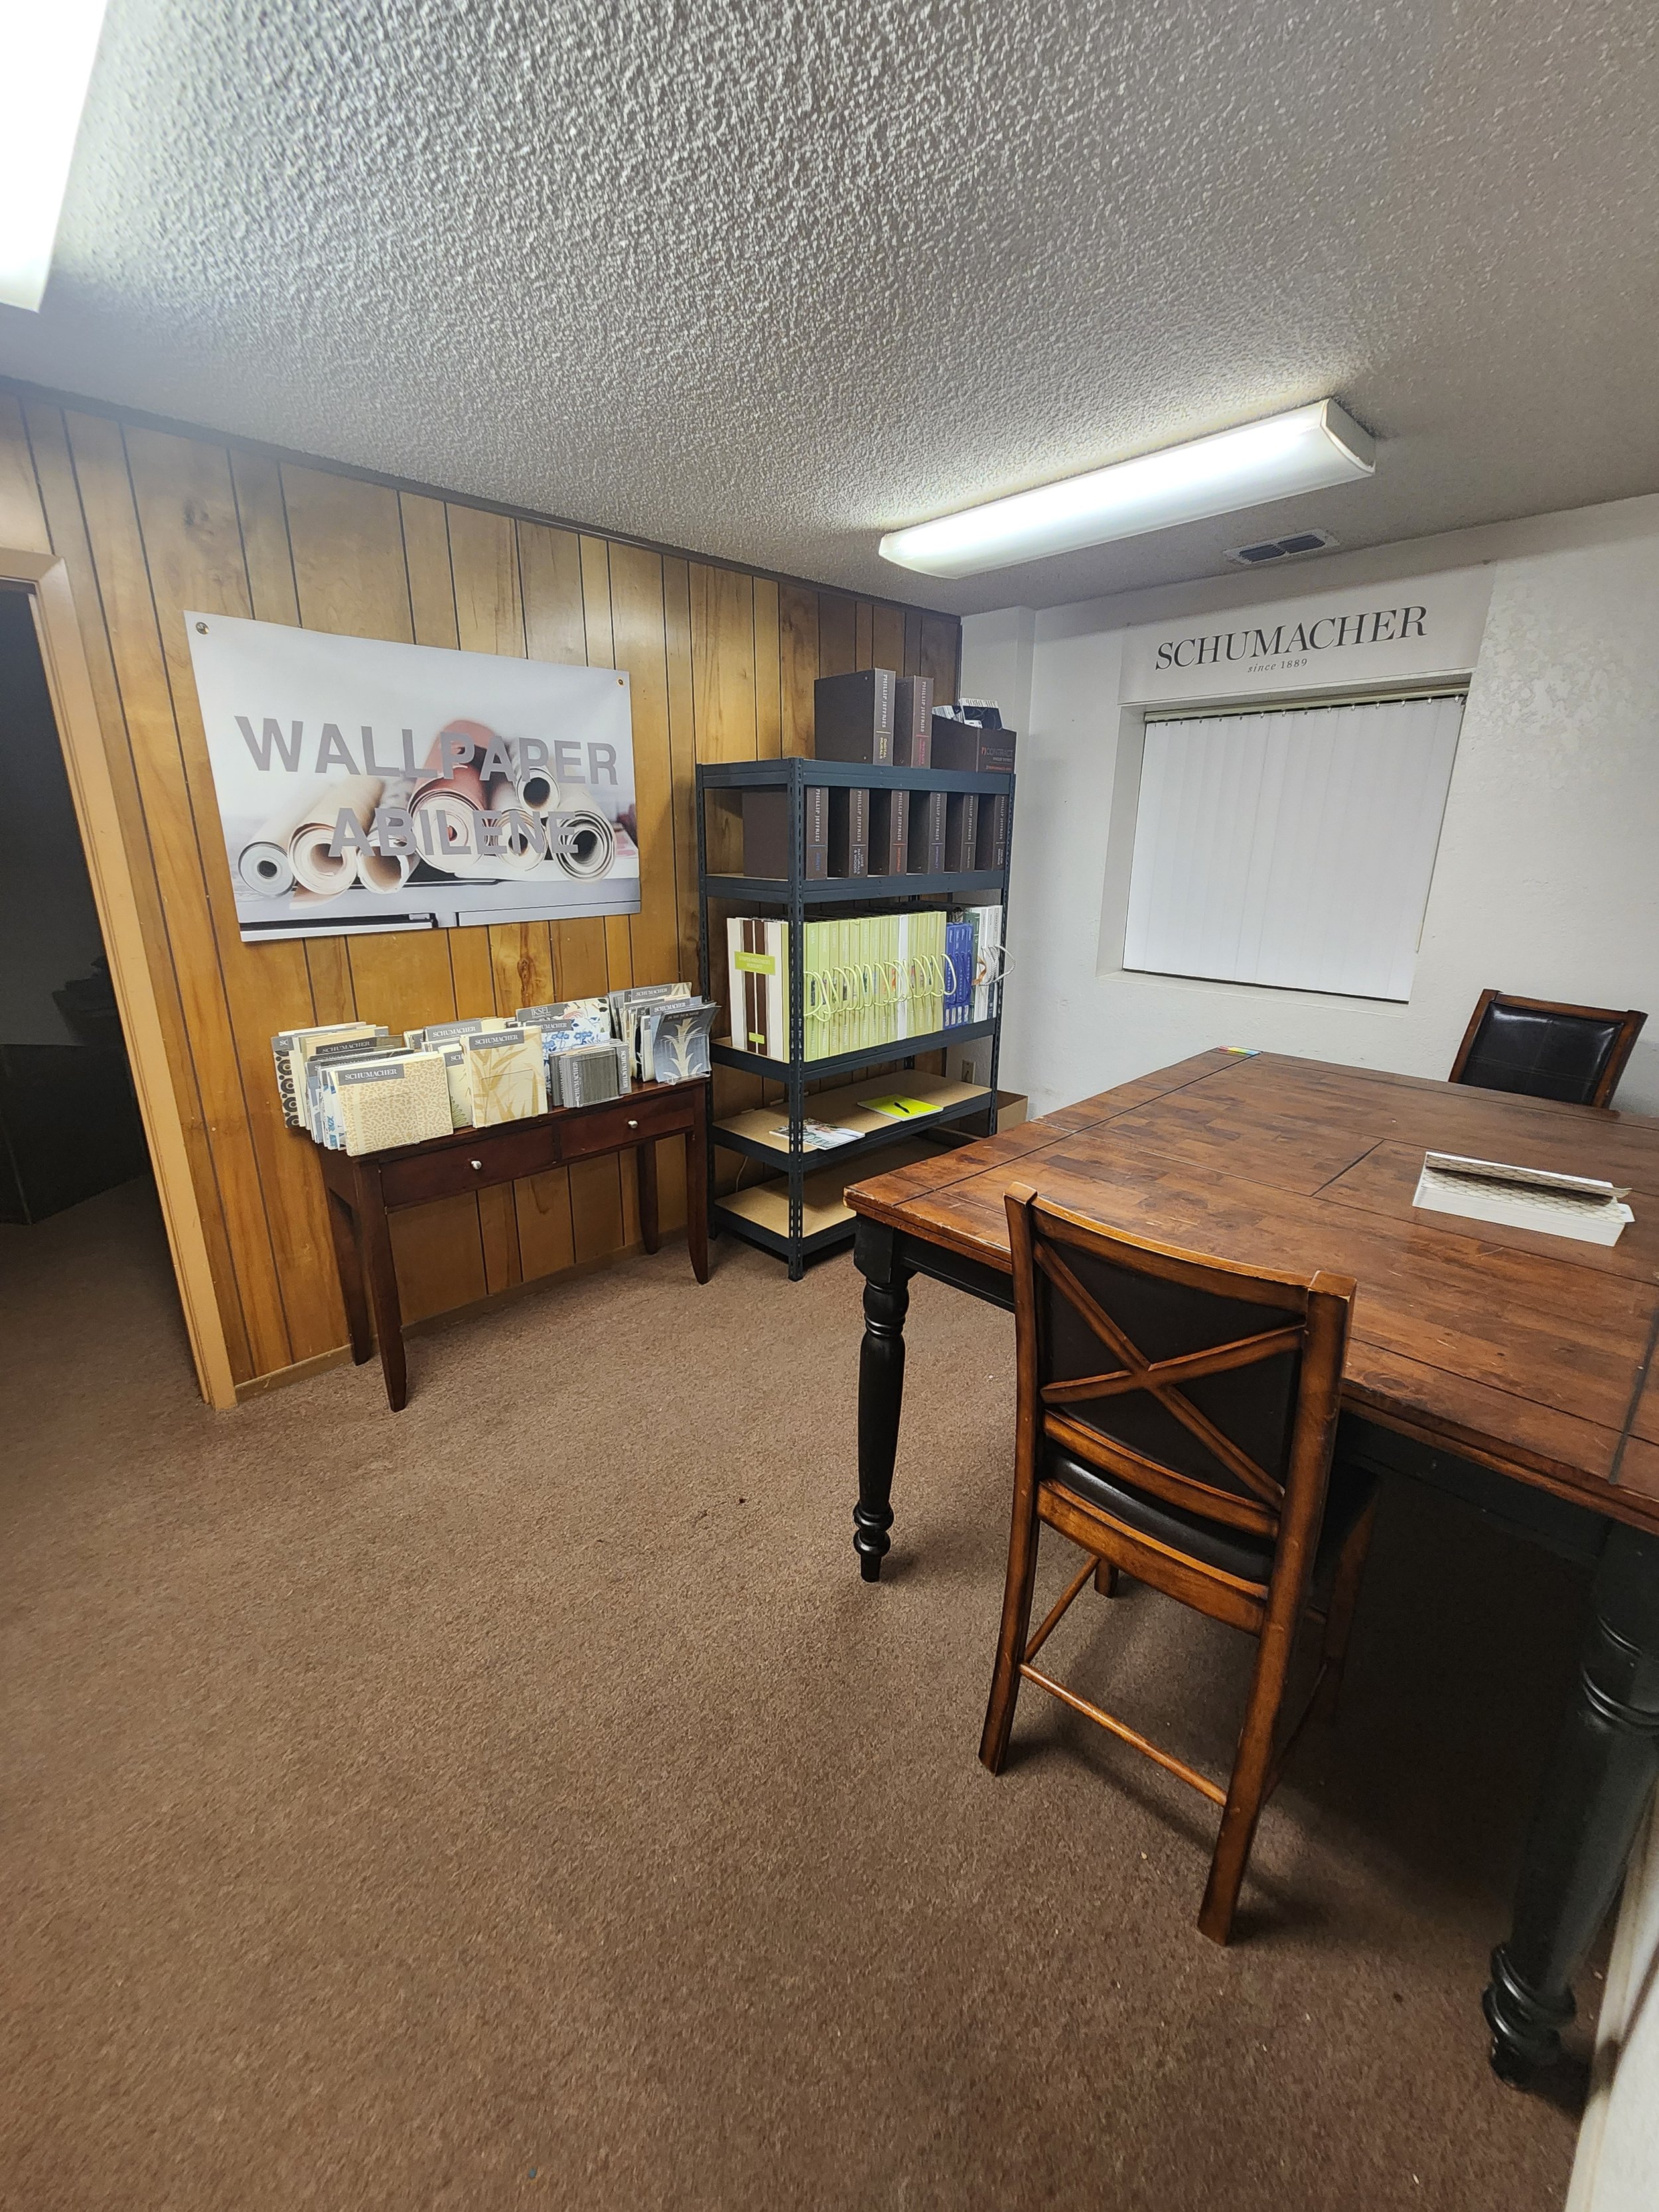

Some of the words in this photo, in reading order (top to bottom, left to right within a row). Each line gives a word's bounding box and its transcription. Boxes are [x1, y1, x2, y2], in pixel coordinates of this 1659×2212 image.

[1155, 605, 1428, 671] SCHUMACHER
[1247, 662, 1277, 673] since
[1280, 658, 1308, 670] 1889
[234, 715, 619, 786] WALLPAPER
[328, 806, 579, 857] ABILENE
[531, 1006, 552, 1016] IKSEL
[654, 1002, 686, 1013] SCHUMACHER
[433, 1026, 476, 1037] SCHUMACHER
[474, 1034, 519, 1046] SCHUMACHER
[322, 1040, 370, 1053] SCHUMACHER
[344, 1068, 397, 1080] SCHUMACHER
